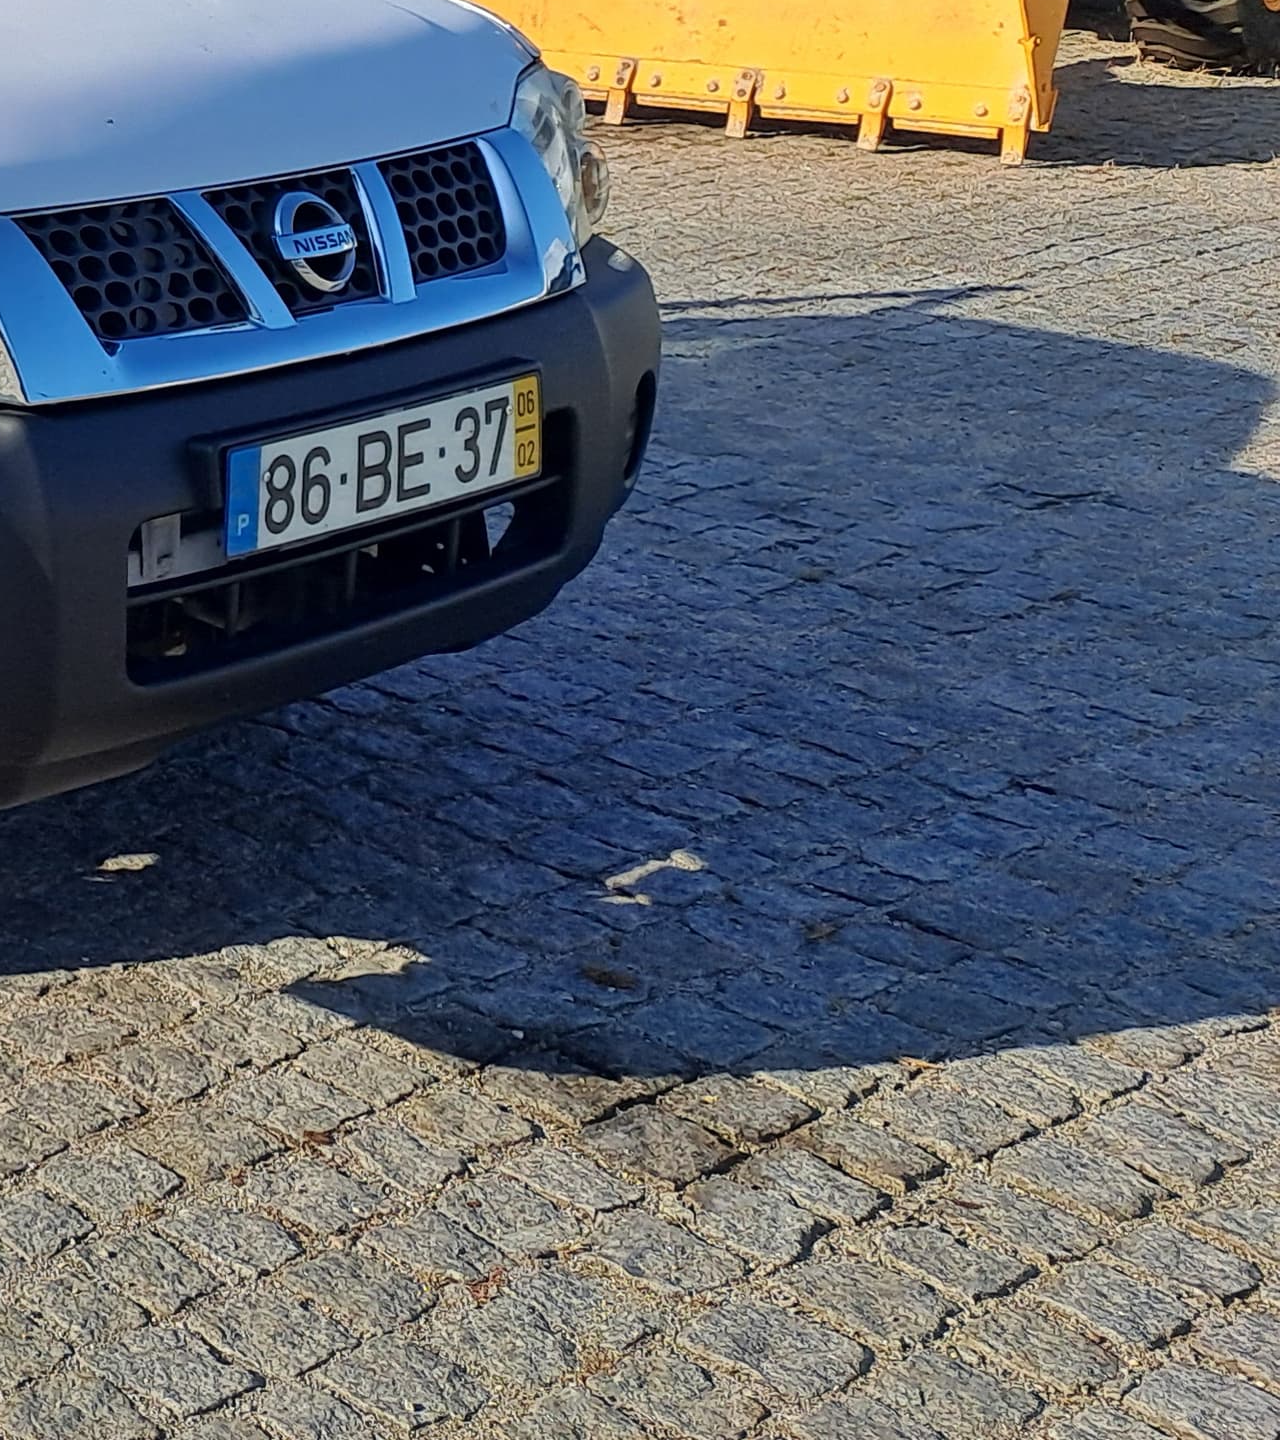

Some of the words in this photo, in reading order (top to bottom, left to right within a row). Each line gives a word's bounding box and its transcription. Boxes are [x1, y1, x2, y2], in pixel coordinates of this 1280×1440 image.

[292, 229, 355, 254] NISSAN
[517, 389, 536, 418] 06
[517, 440, 536, 468] 02
[237, 513, 250, 536] P
